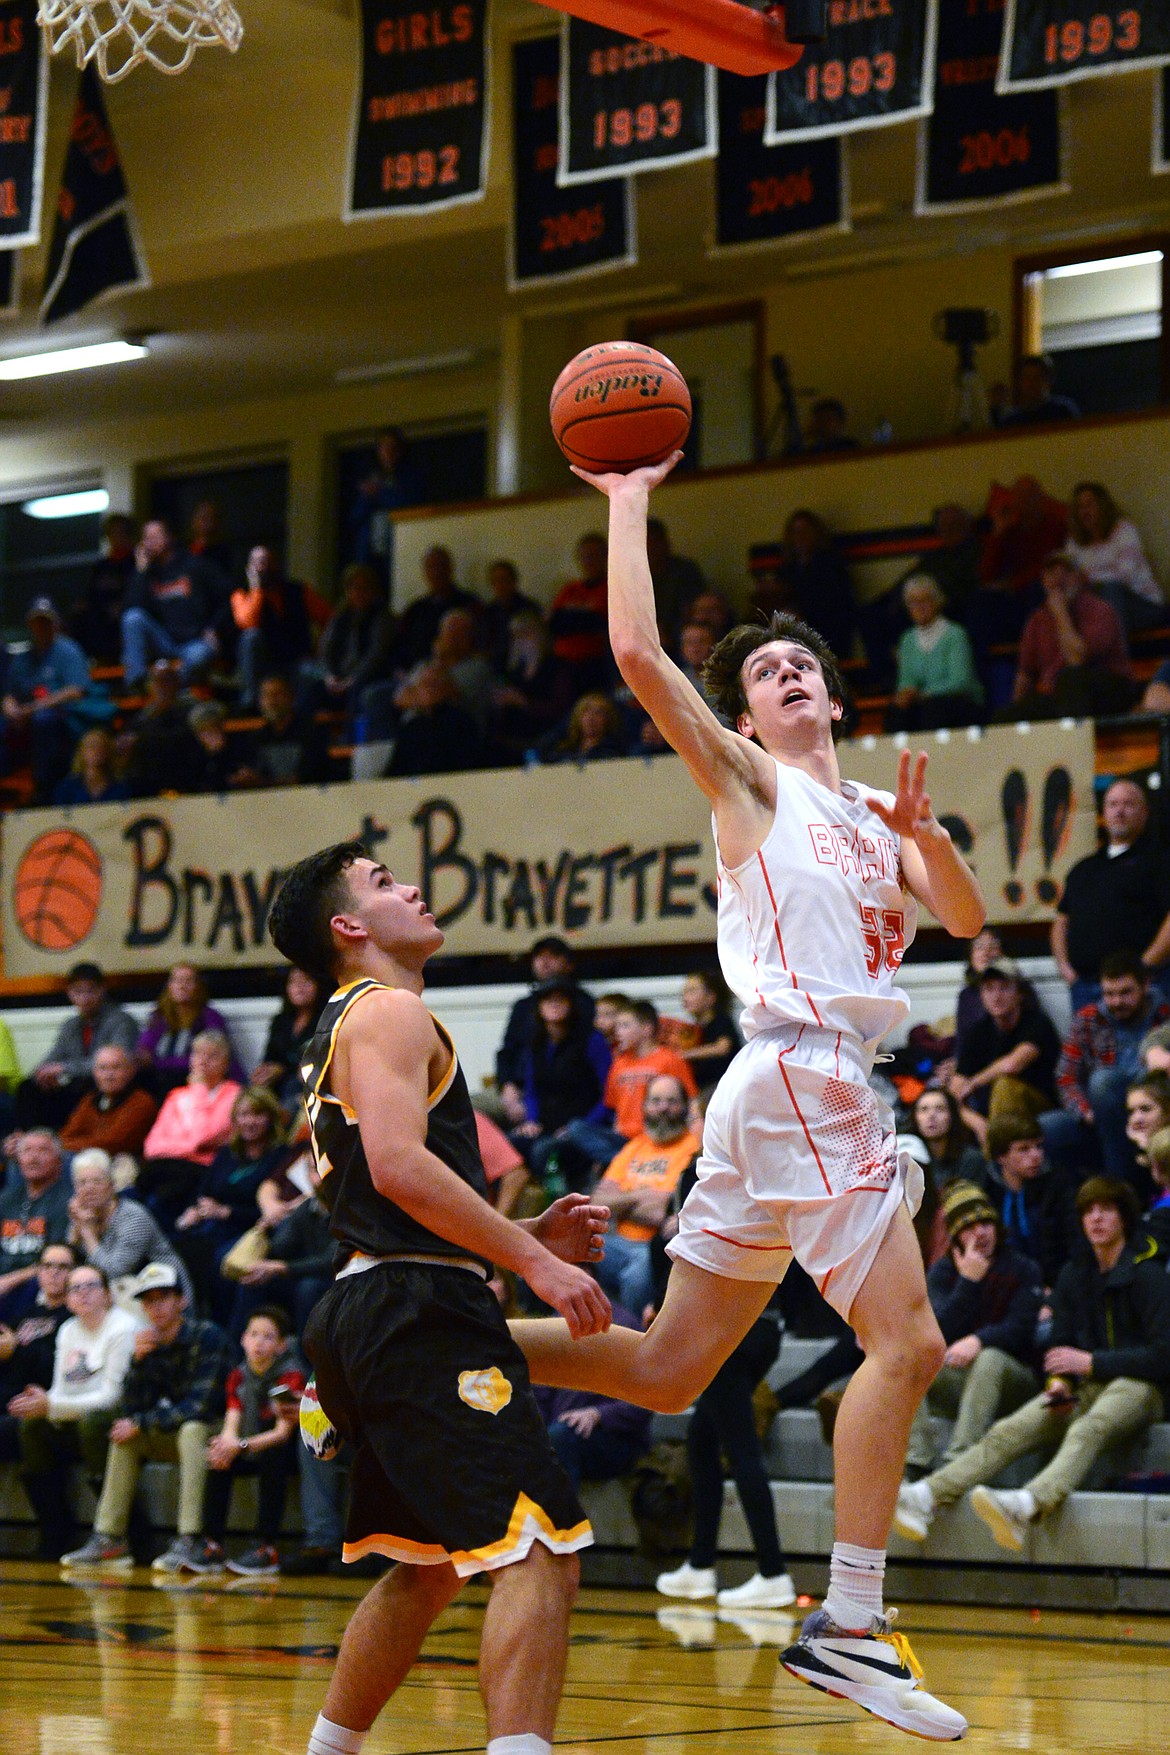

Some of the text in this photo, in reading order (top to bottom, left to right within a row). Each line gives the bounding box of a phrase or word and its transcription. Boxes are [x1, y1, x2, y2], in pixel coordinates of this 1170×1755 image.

[375, 5, 474, 55] GIRLS
[829, 0, 893, 25] RACK
[1045, 9, 1141, 63] 1993
[805, 51, 897, 104] 1993
[593, 98, 682, 150] 1993
[382, 144, 460, 192] 1992
